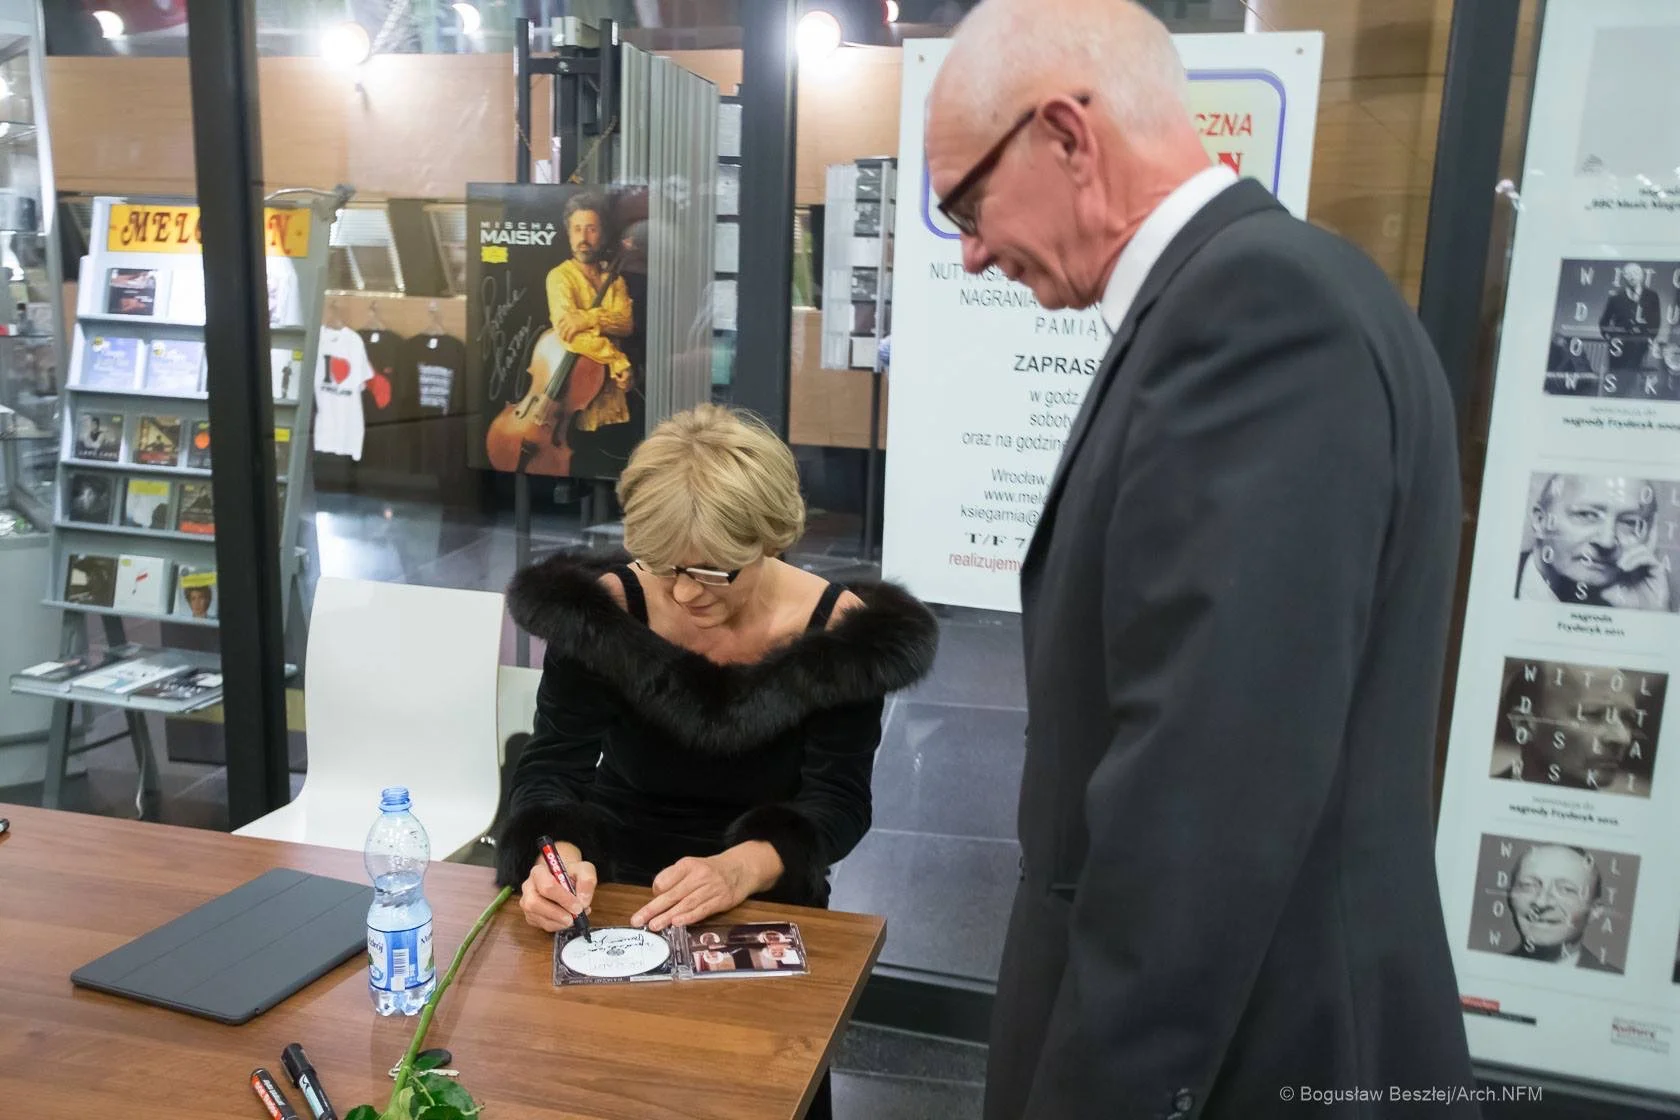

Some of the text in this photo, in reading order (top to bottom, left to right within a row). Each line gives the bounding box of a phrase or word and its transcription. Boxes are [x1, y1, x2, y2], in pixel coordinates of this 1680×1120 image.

[480, 221, 555, 230] MISCHA
[480, 230, 557, 246] MAISKY
[1014, 354, 1103, 376] ZAPRAS
[961, 432, 992, 446] oraz
[995, 434, 1013, 448] na
[965, 532, 1026, 549] T/F 7
[949, 552, 1024, 575] realizujemy
